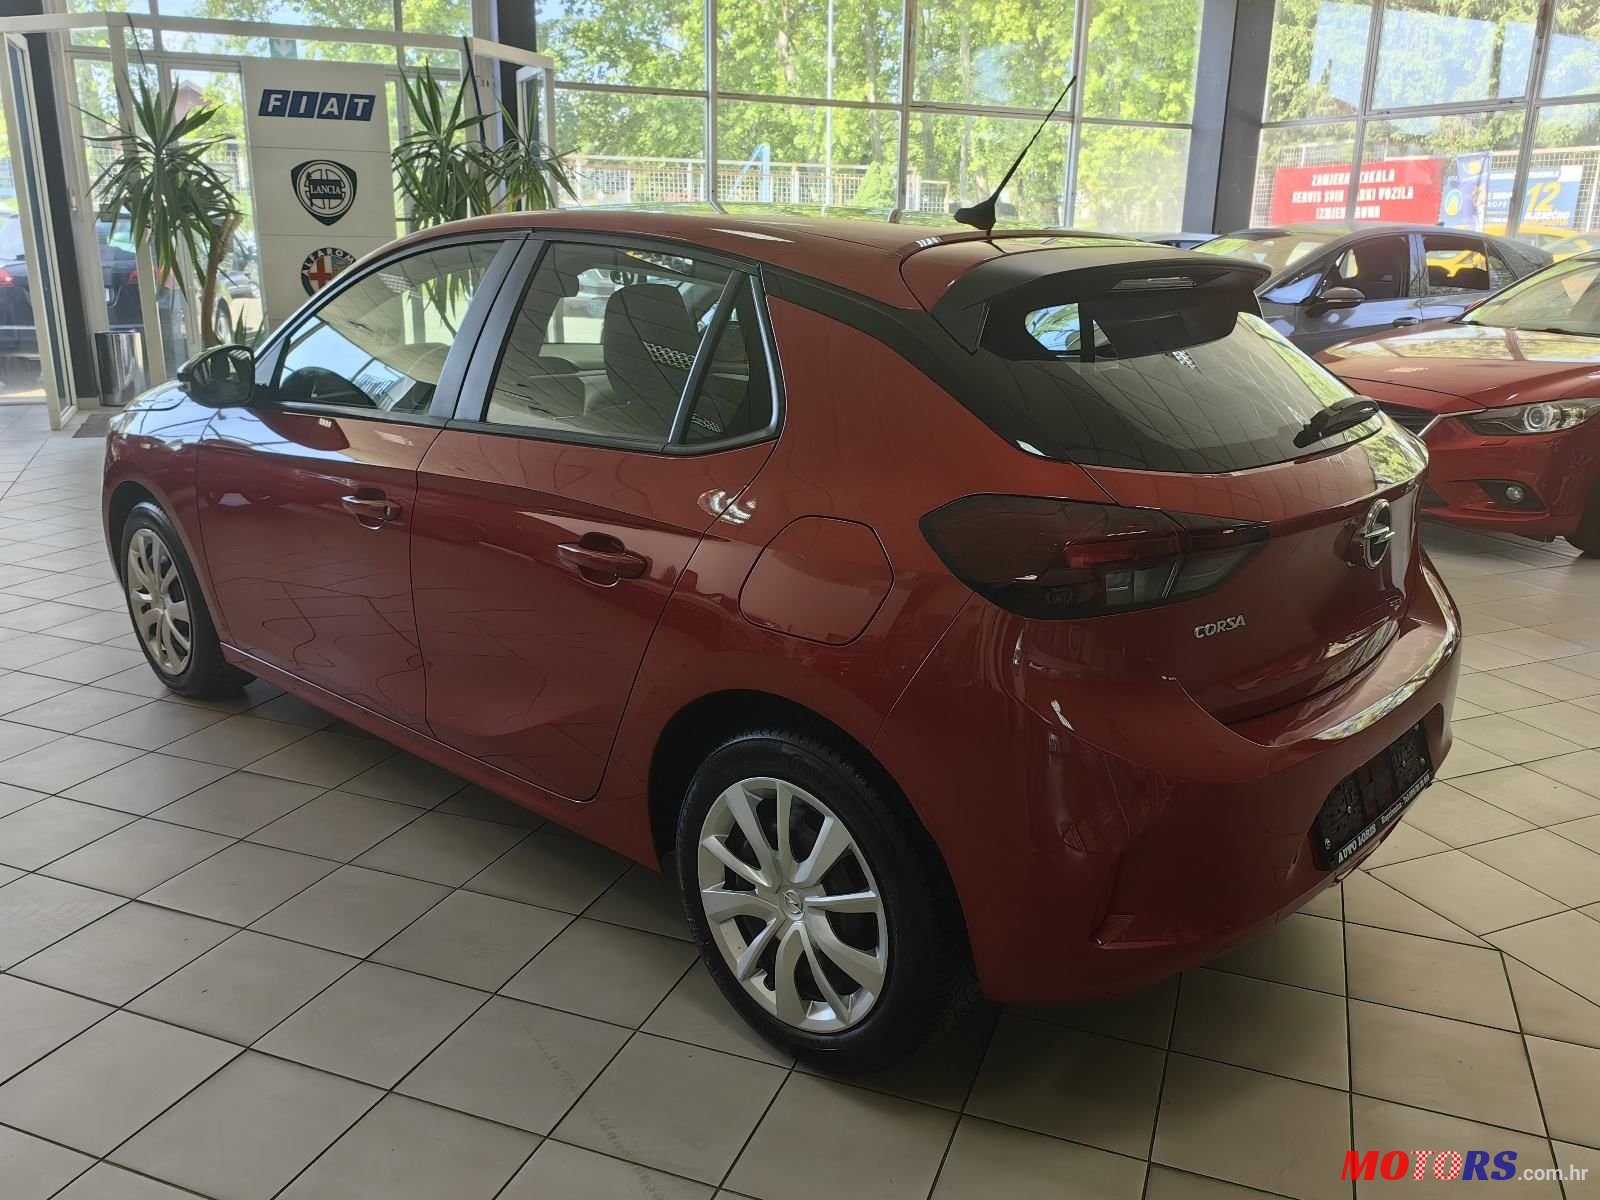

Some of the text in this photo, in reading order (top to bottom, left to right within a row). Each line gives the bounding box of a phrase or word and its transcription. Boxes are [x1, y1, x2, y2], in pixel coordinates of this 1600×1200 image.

[265, 92, 371, 118] FIAT
[1359, 169, 1395, 184] TAKALA
[310, 184, 342, 195] LANCIA
[1292, 191, 1321, 204] SERVIS
[1378, 186, 1414, 201] VOZILA
[1526, 181, 1561, 212] 12
[1316, 207, 1346, 220] IZMJEN
[1193, 614, 1246, 639] CORSA
[1338, 841, 1357, 864] AUTO
[1357, 823, 1377, 848] LORIS
